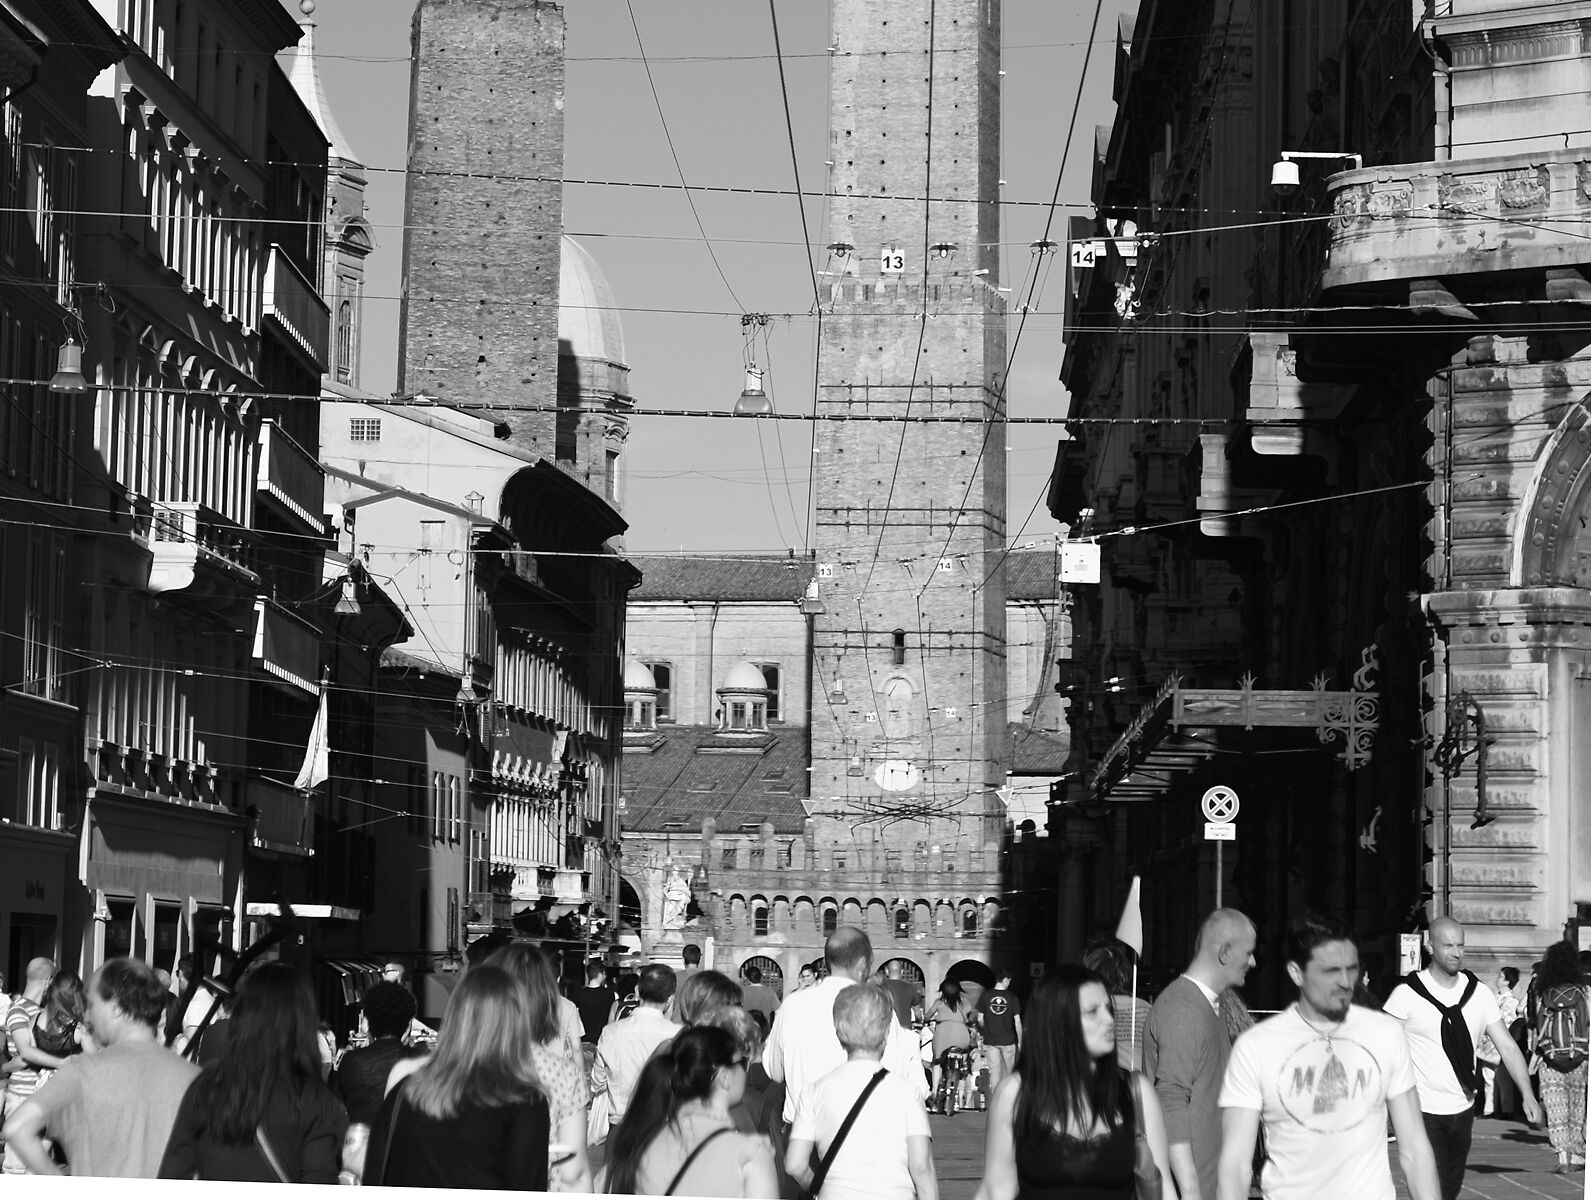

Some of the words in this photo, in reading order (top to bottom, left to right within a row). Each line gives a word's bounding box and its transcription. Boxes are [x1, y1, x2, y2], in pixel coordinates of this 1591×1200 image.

[883, 256, 903, 269] 13
[1073, 251, 1094, 264] 14
[940, 562, 951, 570] 14
[820, 568, 832, 576] 13
